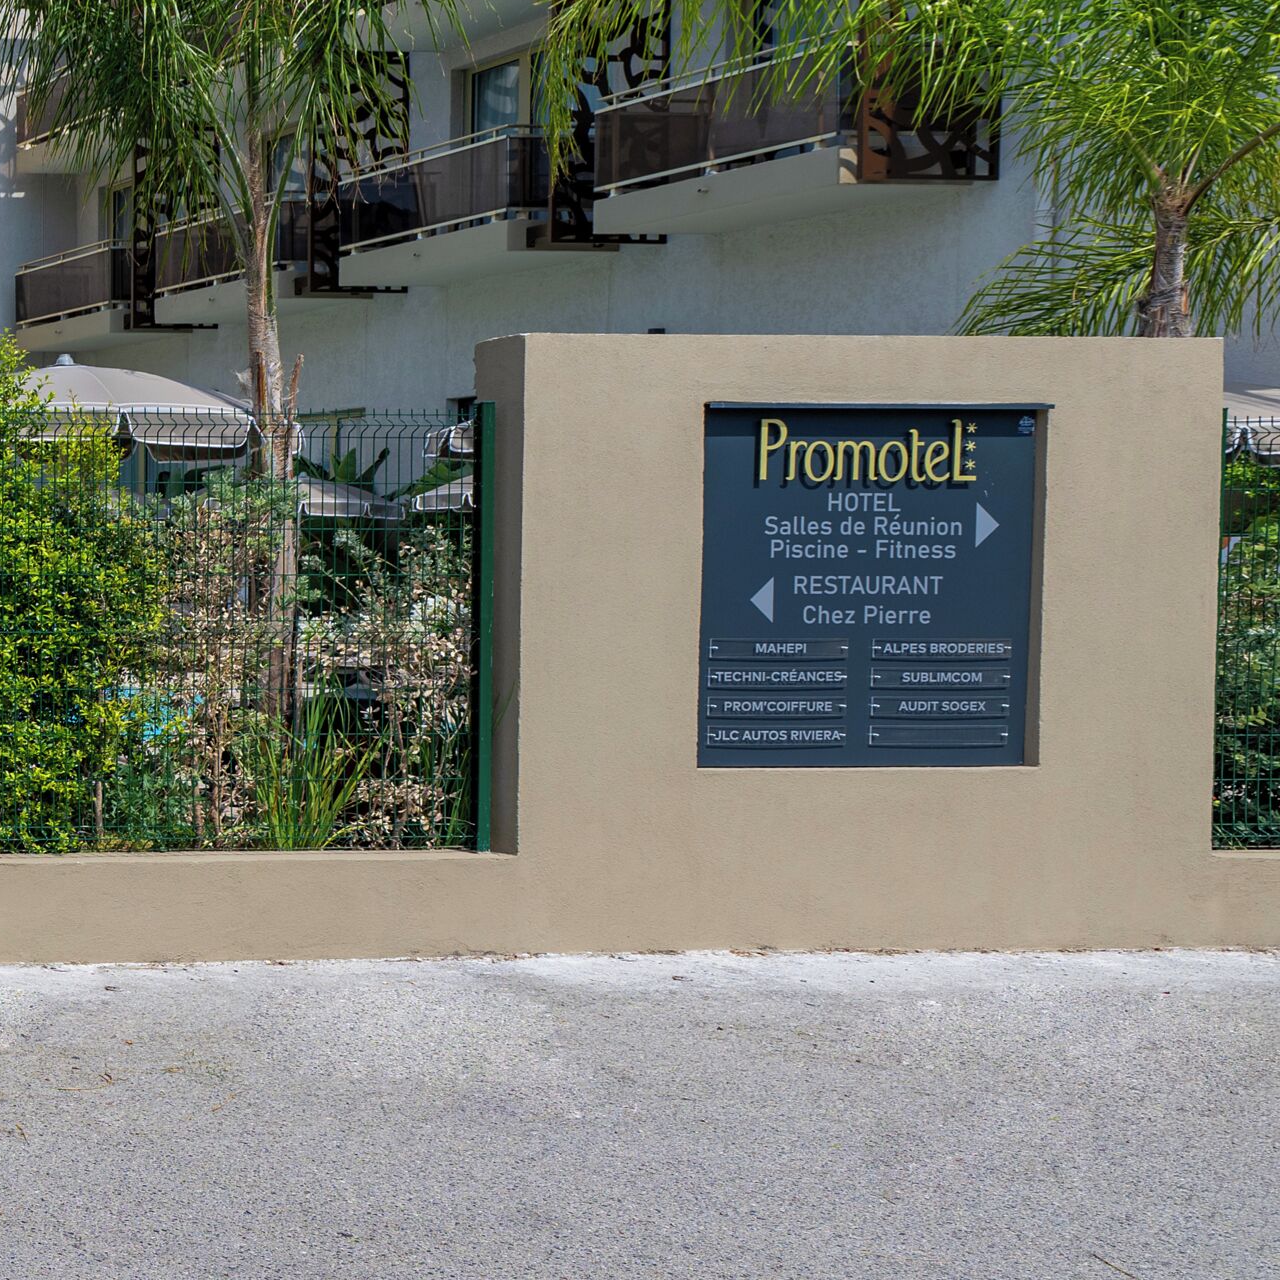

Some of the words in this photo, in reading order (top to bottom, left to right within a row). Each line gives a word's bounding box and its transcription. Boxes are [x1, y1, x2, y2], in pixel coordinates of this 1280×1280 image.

[827, 492, 902, 512] HOTEL
[764, 516, 833, 536] Salles
[840, 516, 866, 536] de
[873, 513, 963, 536] Réunion
[770, 539, 849, 559] Piscine
[875, 539, 956, 559] Fitness
[793, 575, 944, 595] RESTAURANT
[803, 605, 856, 625] Chez
[863, 605, 931, 625] Pierre
[755, 643, 807, 654] MAHEPI
[883, 643, 927, 654] ALPES
[929, 643, 1005, 654] BRODERIES
[716, 668, 842, 682] TECHNI-CRÉANCES
[902, 672, 983, 683] SUBLIMCOM
[724, 701, 833, 712] PROM'COIFFURE
[898, 701, 939, 712] AUDIT
[941, 701, 986, 712] SOGEX
[714, 730, 739, 741] JLC
[742, 730, 788, 741] AUTOS
[790, 730, 841, 741] RIVIERA
